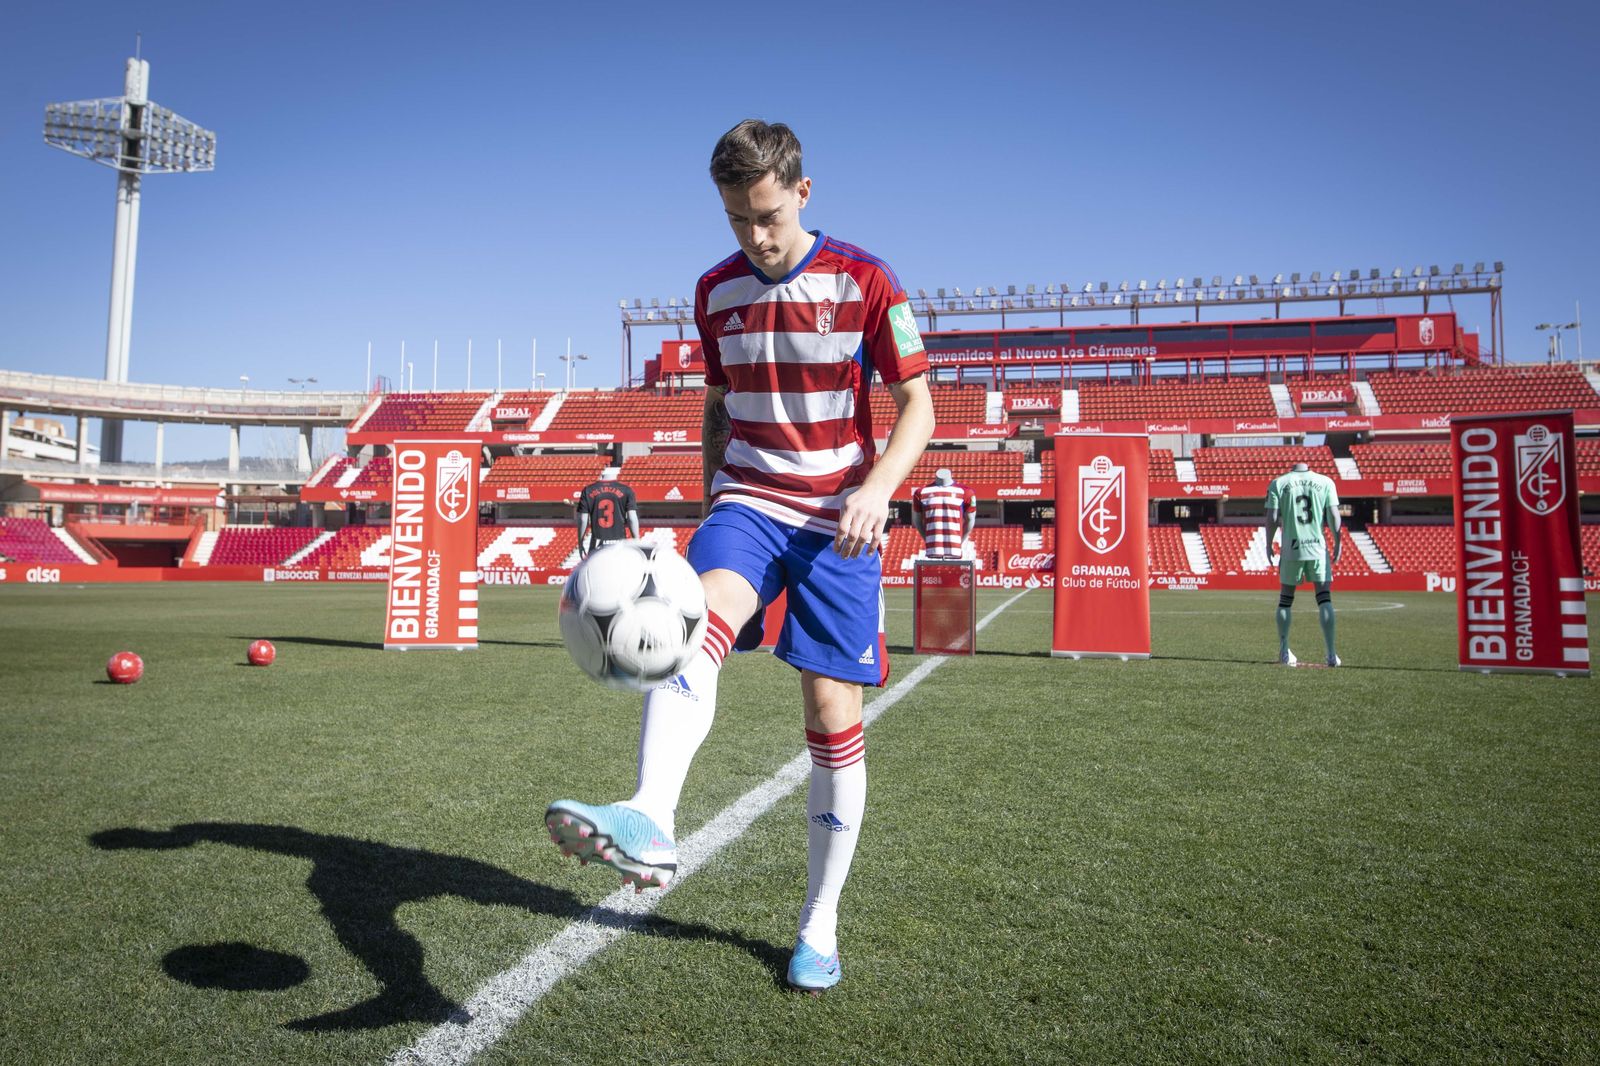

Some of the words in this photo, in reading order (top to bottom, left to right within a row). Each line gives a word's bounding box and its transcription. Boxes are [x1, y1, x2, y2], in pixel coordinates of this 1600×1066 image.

[927, 349, 993, 362] envenidos
[1000, 348, 1012, 360] al
[1016, 347, 1057, 360] Nuevo
[1062, 346, 1084, 359] Los
[1088, 344, 1157, 358] Cármenes
[1302, 390, 1346, 400] IDEAL
[1012, 398, 1053, 409] IDEAL
[496, 407, 531, 418] IDEAL
[1157, 424, 1188, 432] CaixaBank
[1244, 422, 1277, 430] CaixaBank
[1337, 420, 1371, 428] CaixaBank
[598, 499, 614, 528] 3
[1296, 494, 1313, 524] 3
[390, 450, 426, 639] BIENVENIDO
[1461, 427, 1507, 661] BIENVENIDO
[26, 565, 60, 582] alsa
[1071, 565, 1131, 576] GRANADA
[976, 573, 1022, 588] LaLiga
[1062, 576, 1087, 588] Club
[1089, 577, 1103, 588] de
[1106, 578, 1140, 589] Fútbol
[425, 549, 441, 639] GRANADACF
[1512, 550, 1534, 661] GRANADACF
[811, 816, 850, 832] adidas
